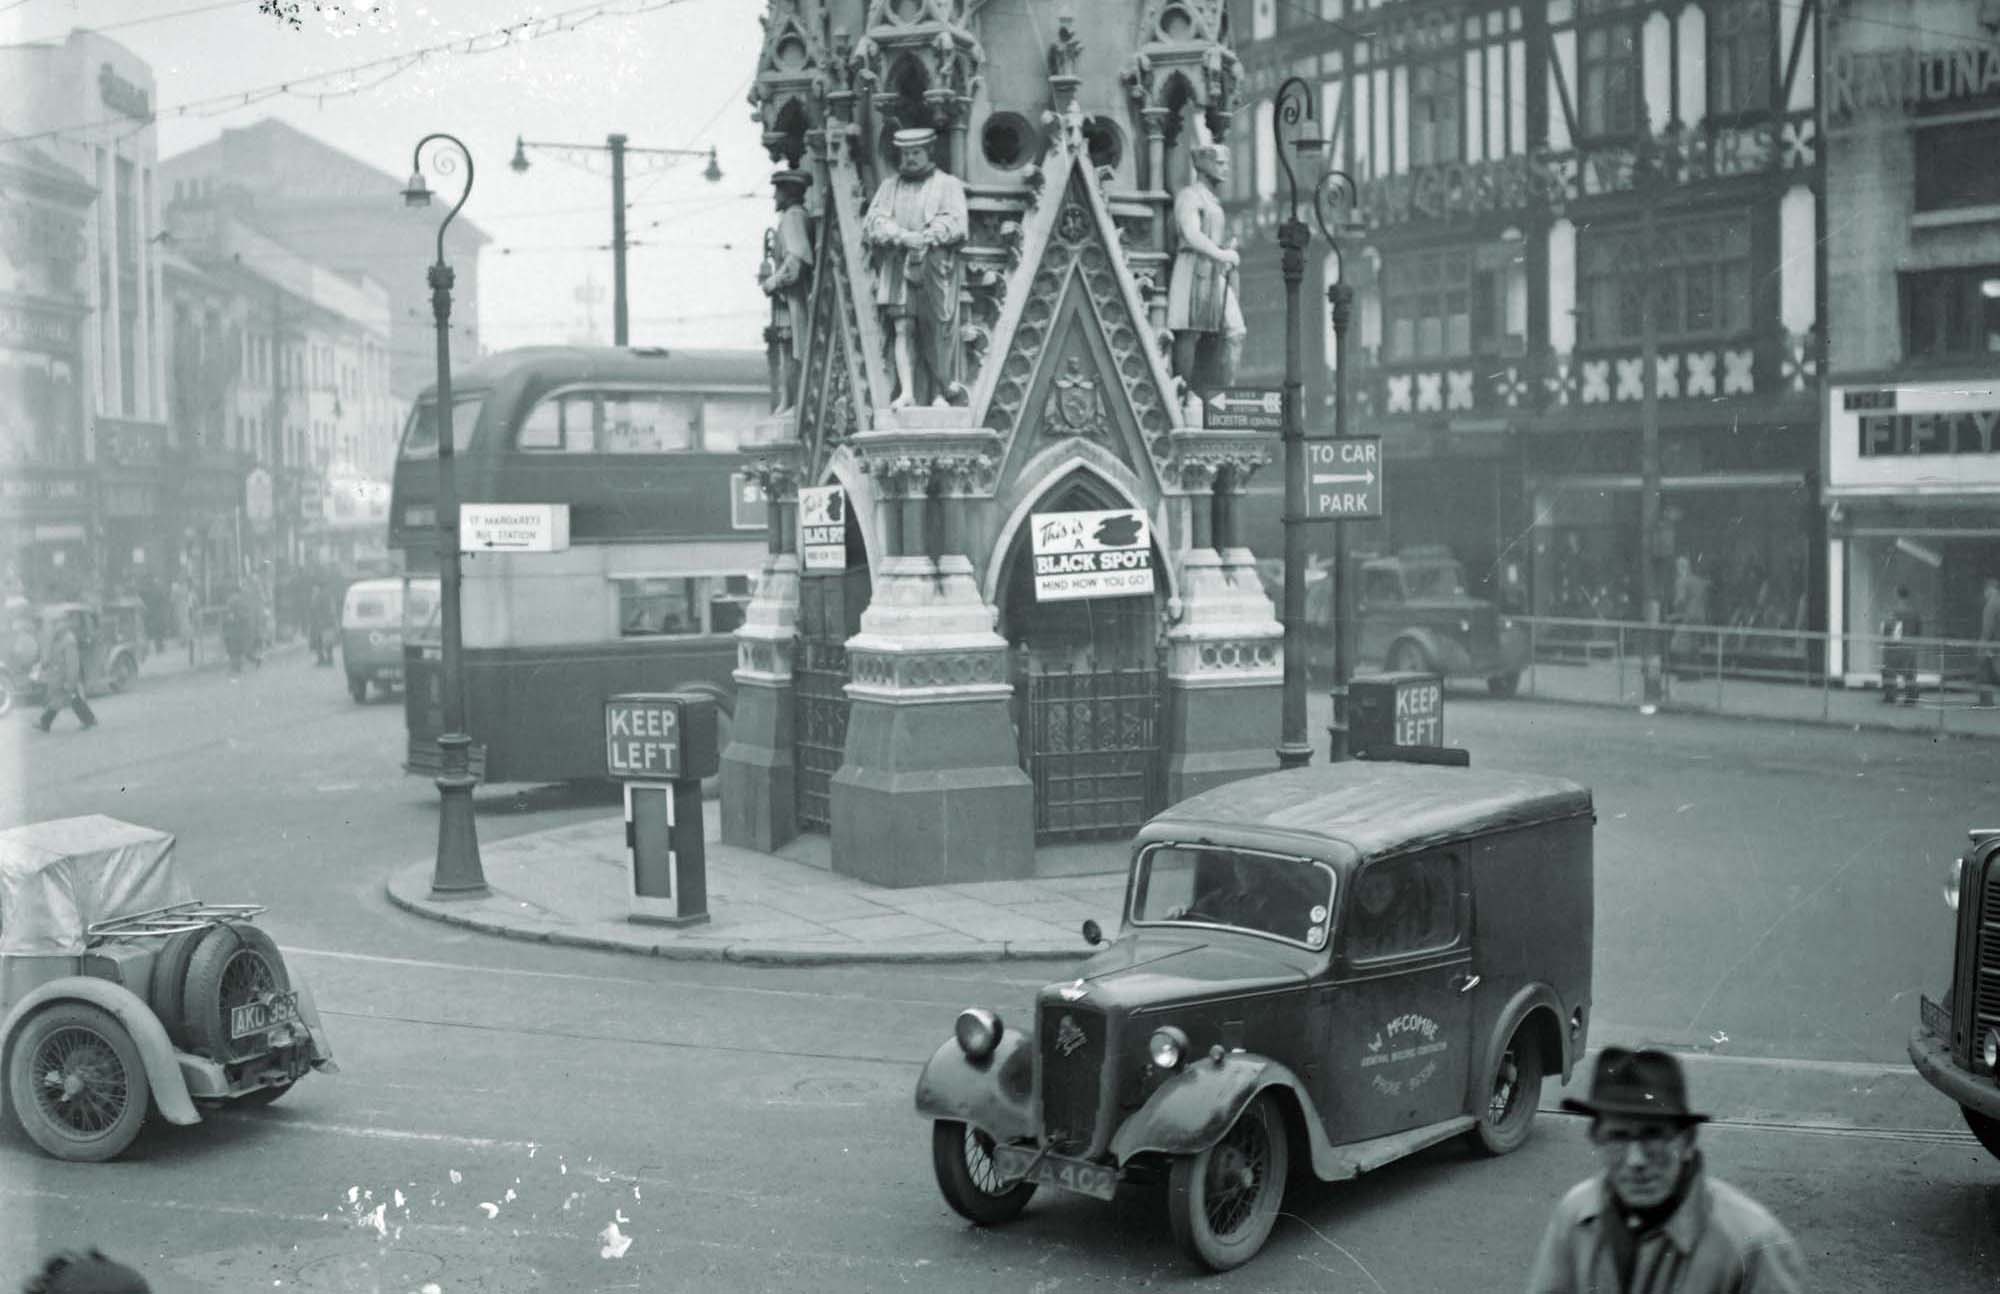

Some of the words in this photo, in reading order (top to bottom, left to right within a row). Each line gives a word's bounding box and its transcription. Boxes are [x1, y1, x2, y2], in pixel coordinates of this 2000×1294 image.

[1865, 412, 2000, 456] FIFTY
[1310, 445, 1334, 463] TO
[1342, 444, 1376, 463] CAR
[1320, 493, 1368, 512] PARK
[498, 530, 536, 539] STATION
[1041, 521, 1067, 547] This
[1072, 520, 1083, 535] is
[1074, 538, 1085, 549] A
[1036, 553, 1097, 575] BLACK
[1100, 550, 1150, 570] SPOT
[1042, 580, 1070, 591] MIND
[1073, 579, 1097, 589] HOW
[1104, 577, 1124, 587] YOU
[1396, 686, 1439, 716] KEEP
[611, 709, 676, 737] KEEP
[1396, 717, 1438, 747] LEFT
[612, 743, 677, 770] LEFT
